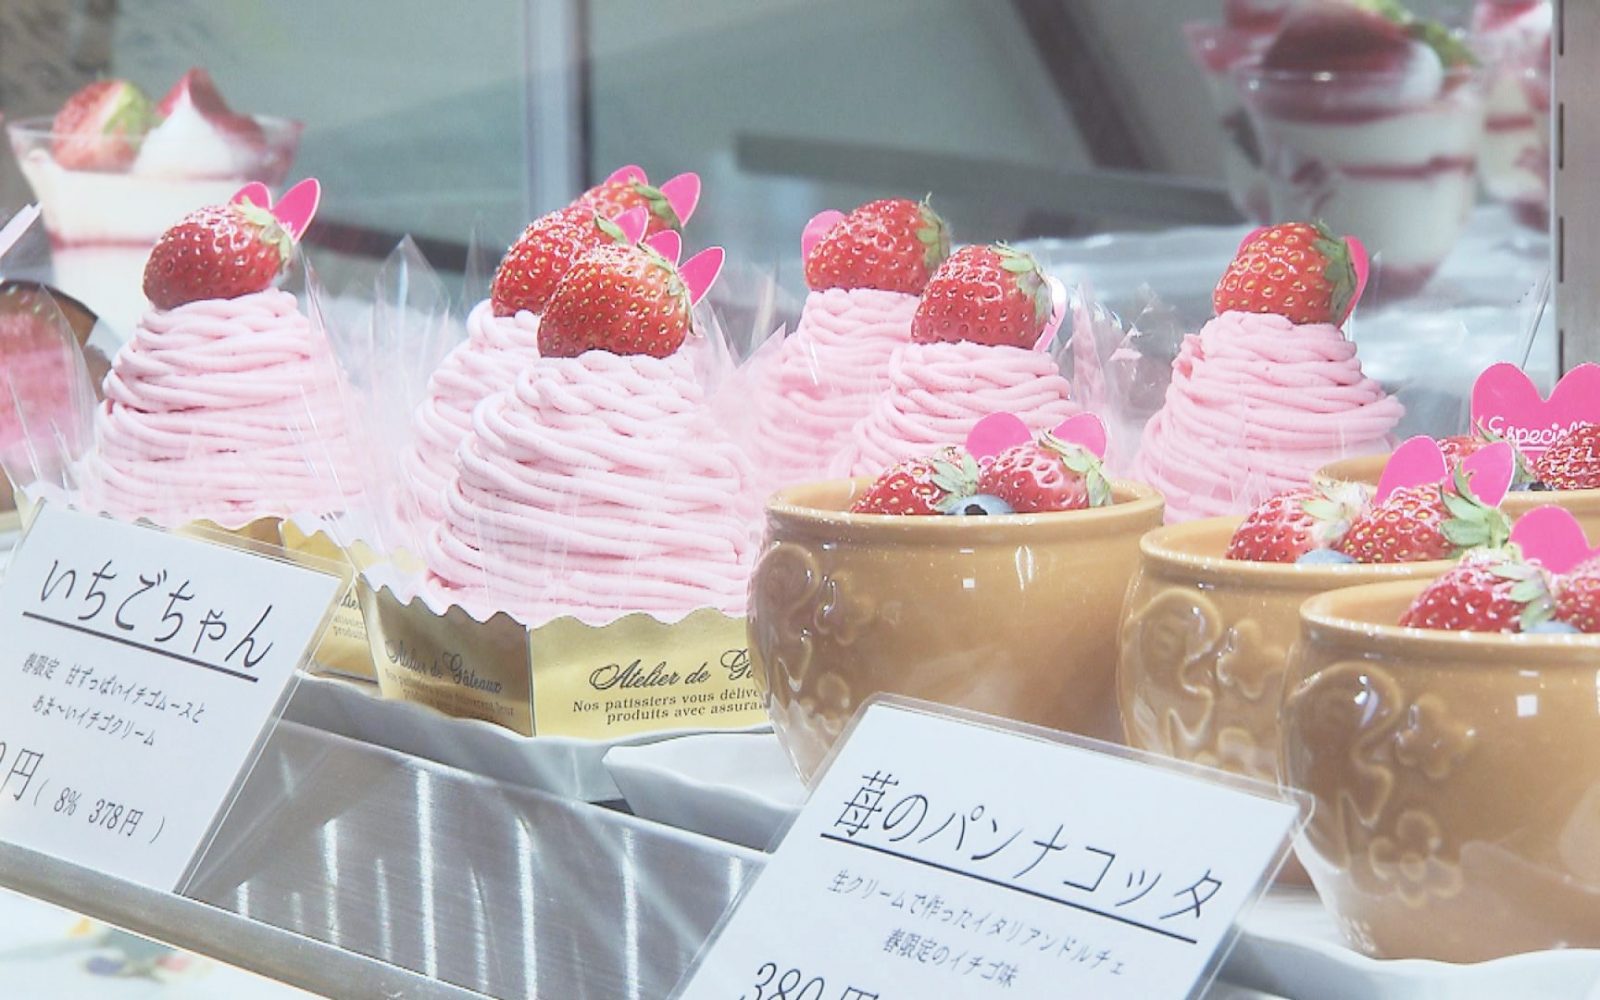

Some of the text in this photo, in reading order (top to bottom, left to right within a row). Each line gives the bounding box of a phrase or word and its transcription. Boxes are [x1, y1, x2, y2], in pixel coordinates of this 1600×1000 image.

[41, 559, 274, 668] いちごちゃん
[22, 652, 60, 679] 春限定
[589, 659, 680, 690] Atelier
[684, 662, 711, 684] de
[573, 700, 600, 713] Nos
[605, 695, 677, 713] patissiers
[682, 692, 715, 704] vous
[607, 708, 670, 725] produits
[674, 706, 704, 718] avec
[54, 786, 82, 816] 8%
[88, 798, 144, 837] 378円
[834, 770, 1223, 920] 苺のパンナコッタ
[827, 869, 1125, 976] 生クリームで作ったイタリアンドルチェ
[883, 928, 1019, 988] 春限定のイチゴ味
